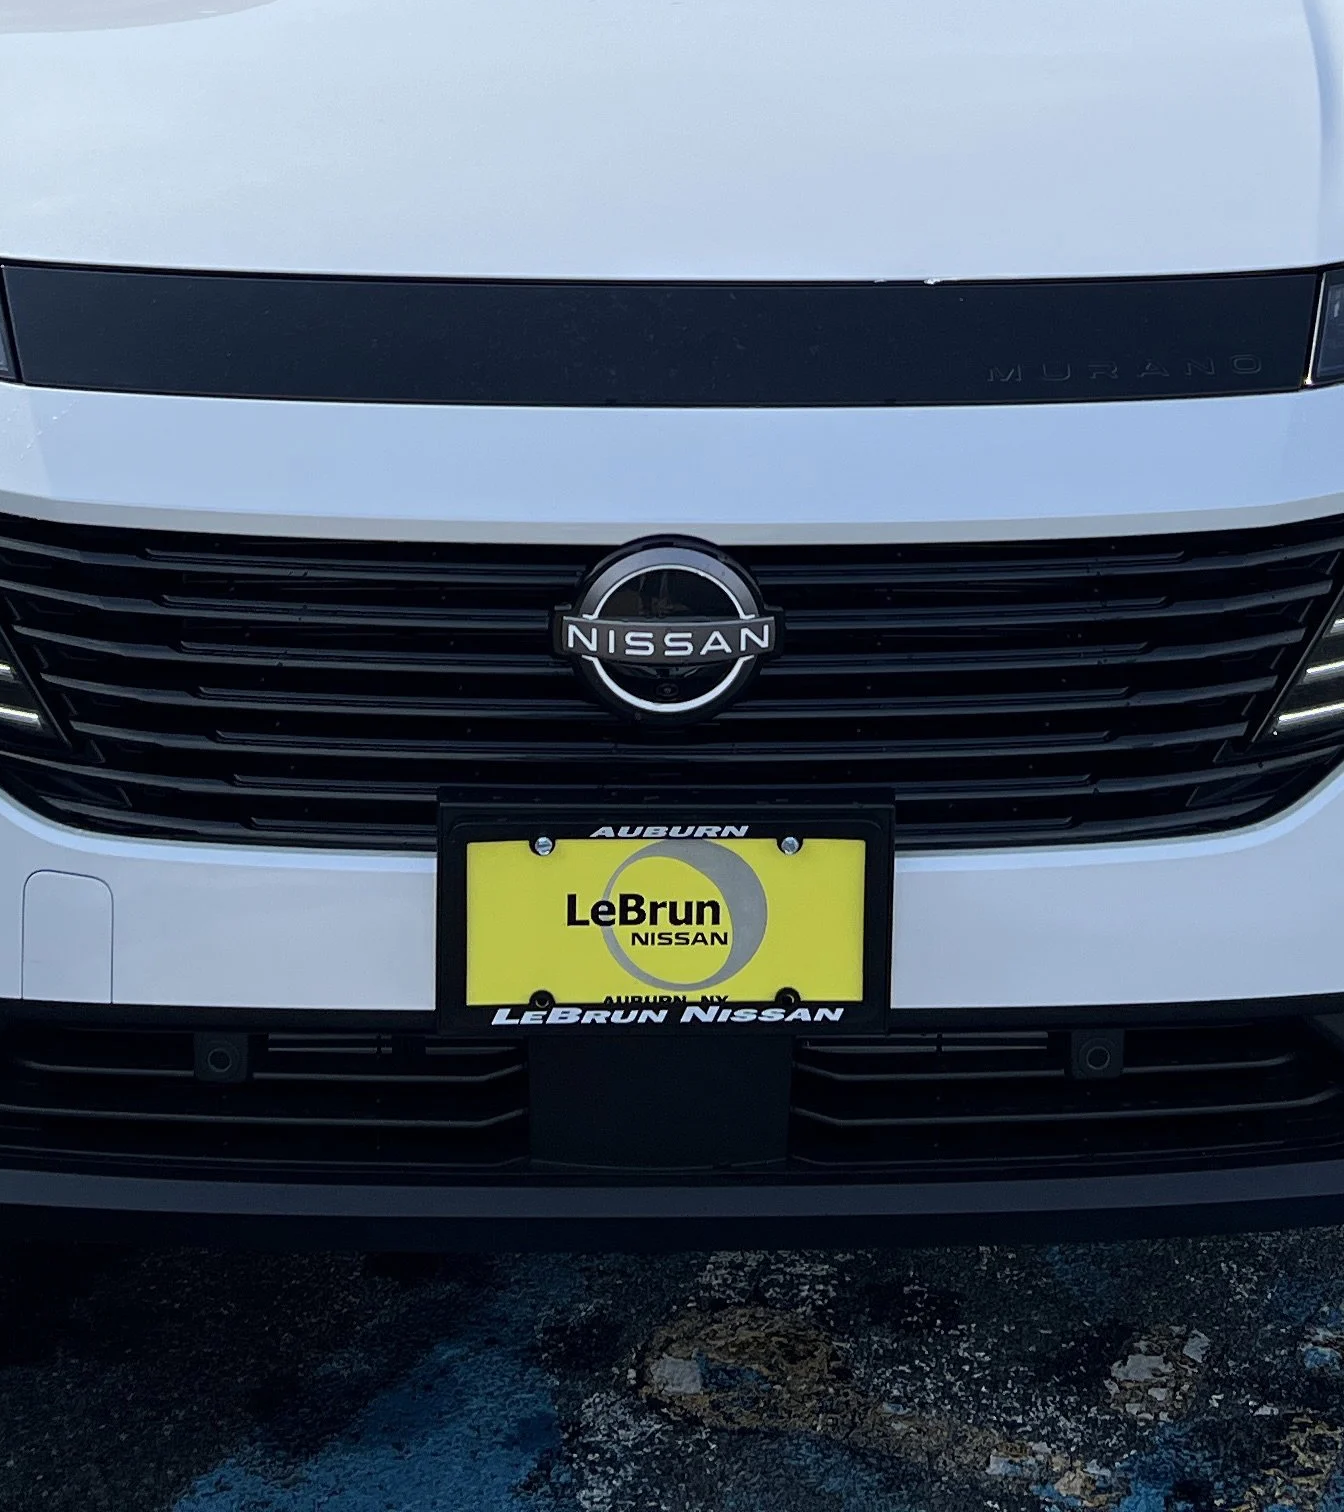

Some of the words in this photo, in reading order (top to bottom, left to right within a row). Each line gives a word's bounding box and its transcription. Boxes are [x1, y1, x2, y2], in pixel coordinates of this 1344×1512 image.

[987, 354, 1262, 382] MURANO
[567, 621, 770, 656] NISSAN
[589, 825, 749, 839] AUBURN
[566, 893, 721, 926] LeBrun
[631, 932, 729, 947] NISSAN
